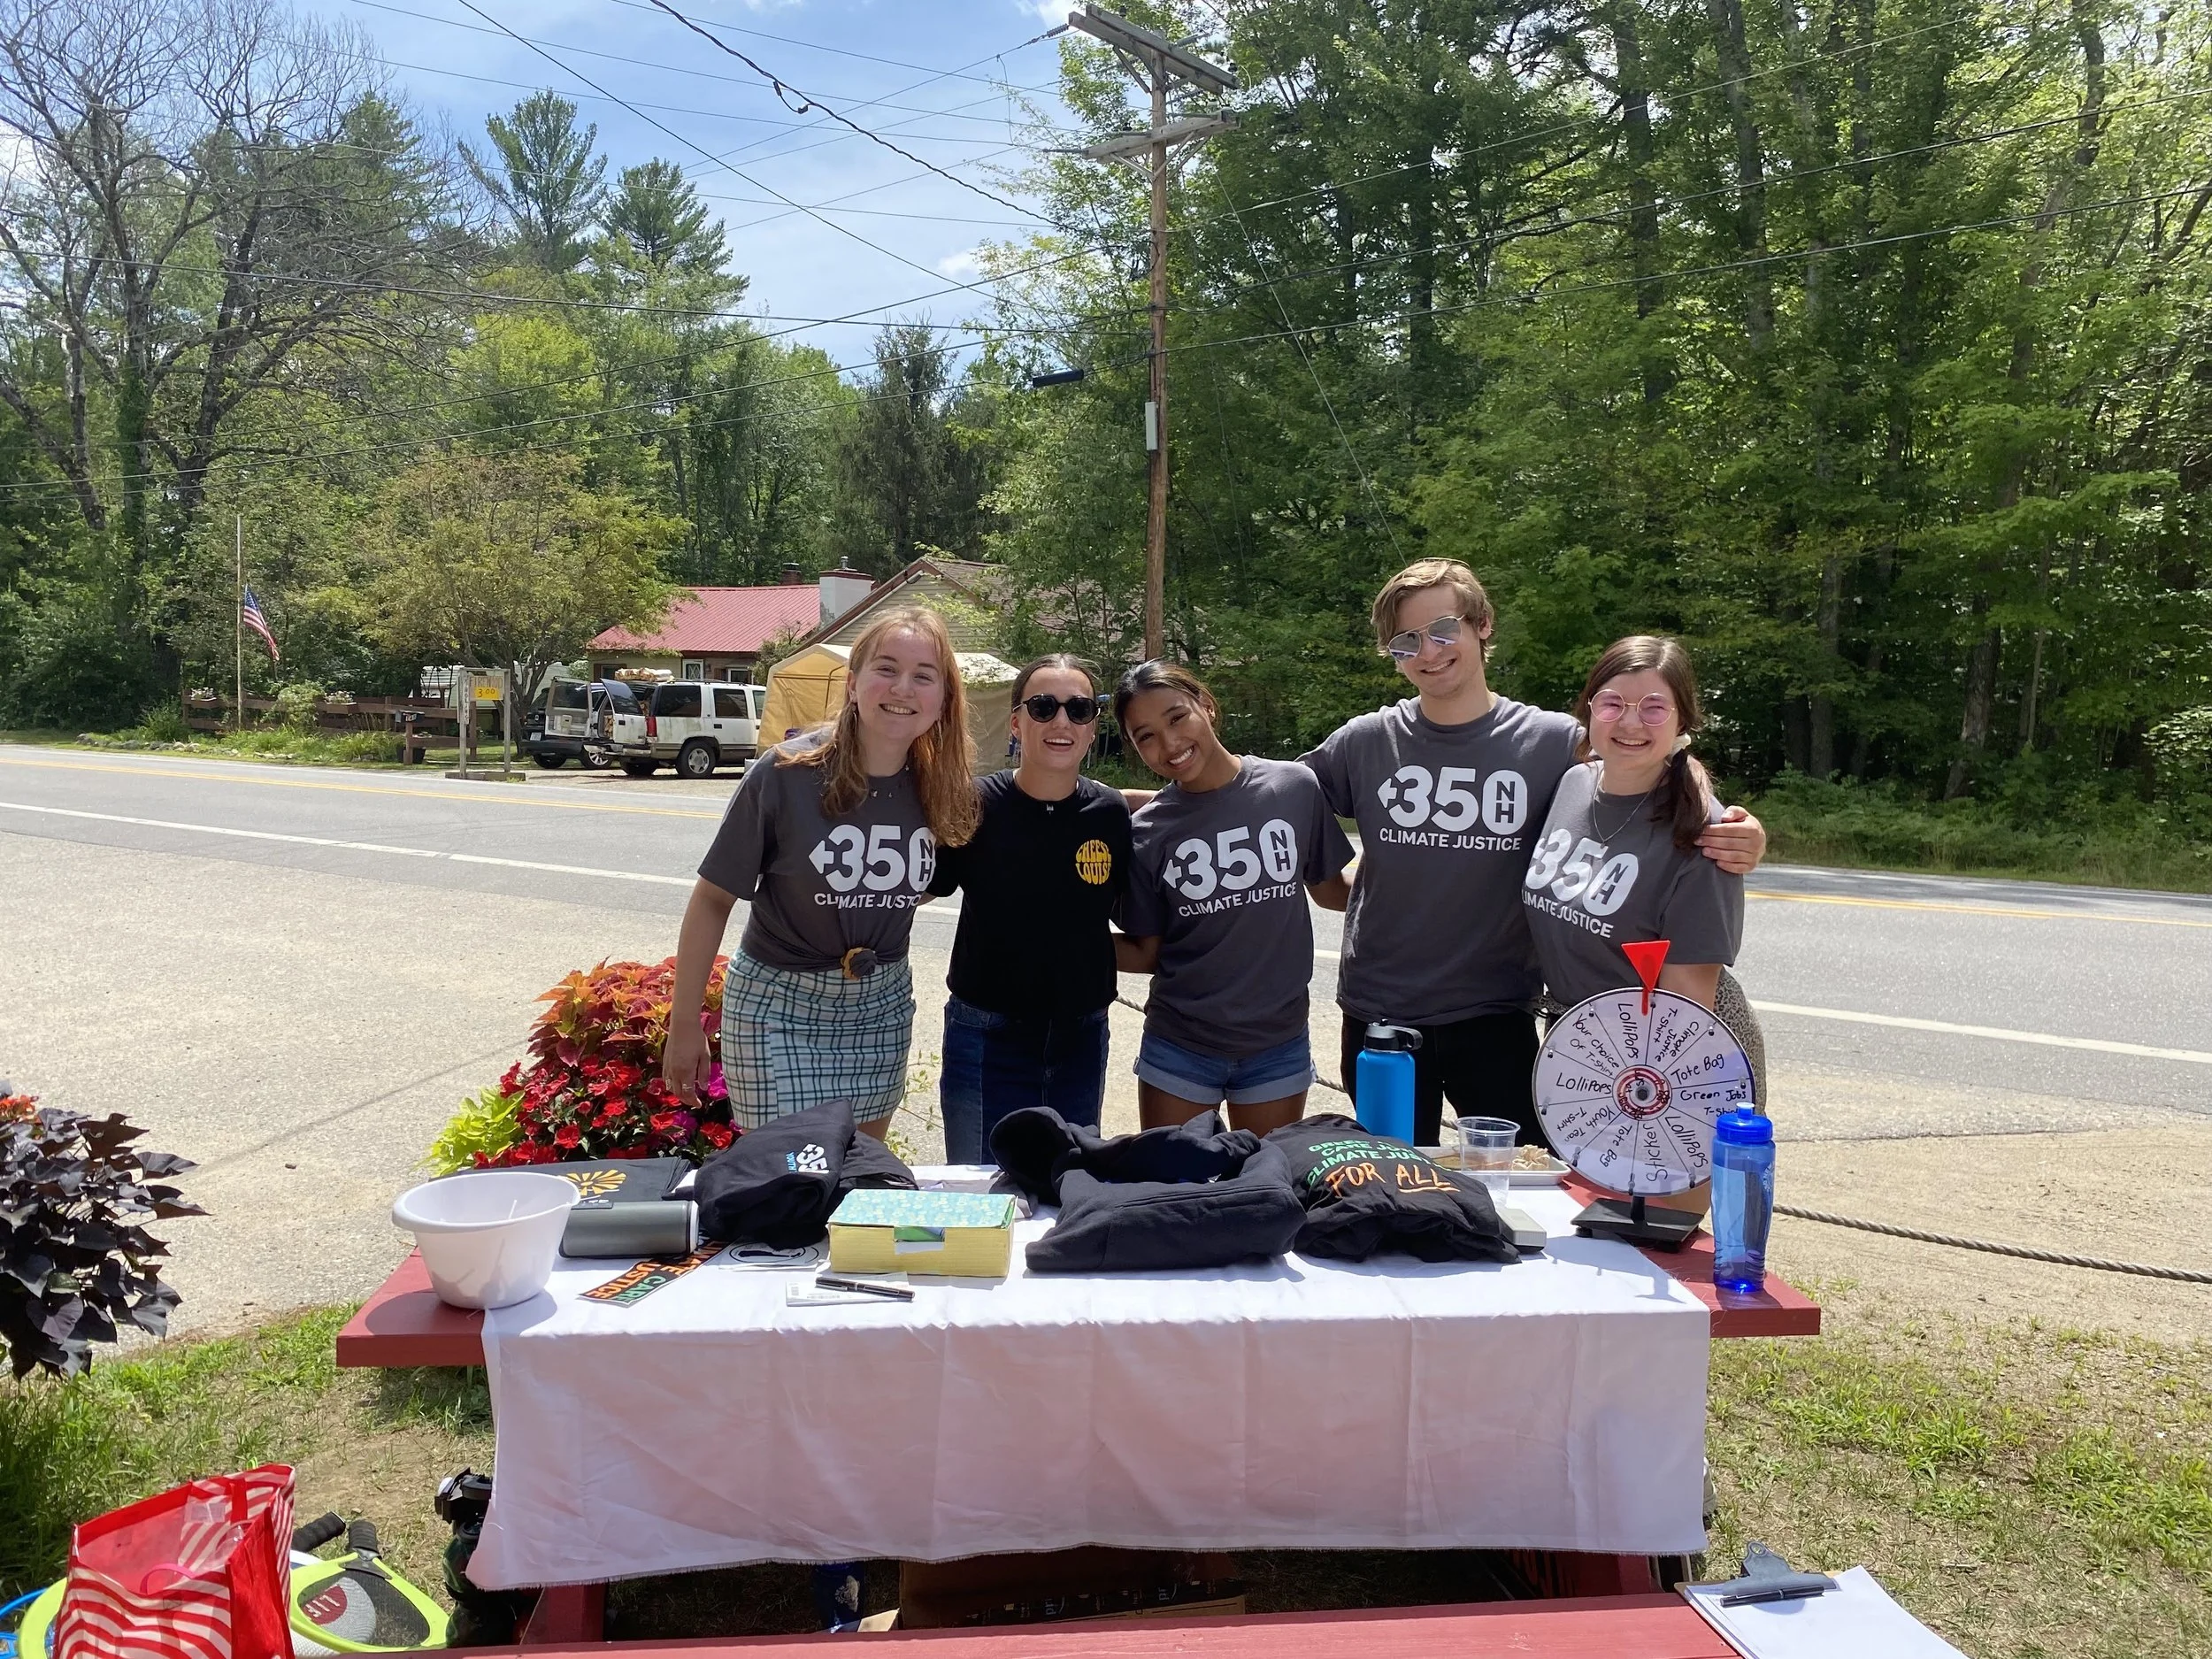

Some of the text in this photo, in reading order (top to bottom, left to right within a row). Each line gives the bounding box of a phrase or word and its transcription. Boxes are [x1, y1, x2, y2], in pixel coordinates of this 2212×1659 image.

[1388, 764, 1528, 836] 350
[1075, 839, 1112, 863] CHEESE
[1379, 827, 1523, 851] CLIMATE JUSTICE
[826, 824, 937, 892] 350
[1075, 862, 1112, 885] LOUISE
[1175, 818, 1298, 901] 350
[1525, 828, 1640, 917] 350
[814, 893, 875, 910] CLIMATE
[1179, 881, 1297, 917] CLIMATE JUSTICE
[1521, 888, 1615, 938] LIMATE JUSTICE
[1572, 1013, 1592, 1036] Your
[1669, 1021, 1700, 1057] Climate
[1655, 1028, 1678, 1063] Justice
[1671, 1053, 1724, 1085] Tote Bag
[1680, 1088, 1747, 1102] Green Jobs
[786, 1151, 797, 1171] YOUTH
[796, 1145, 830, 1174] 35
[1321, 1142, 1372, 1157] CARE
[1599, 1125, 1632, 1168] Tote Bag
[1306, 1149, 1384, 1186] CLIMATE
[1325, 1162, 1452, 1199] FOR ALL
[586, 1261, 662, 1300] USTICE
